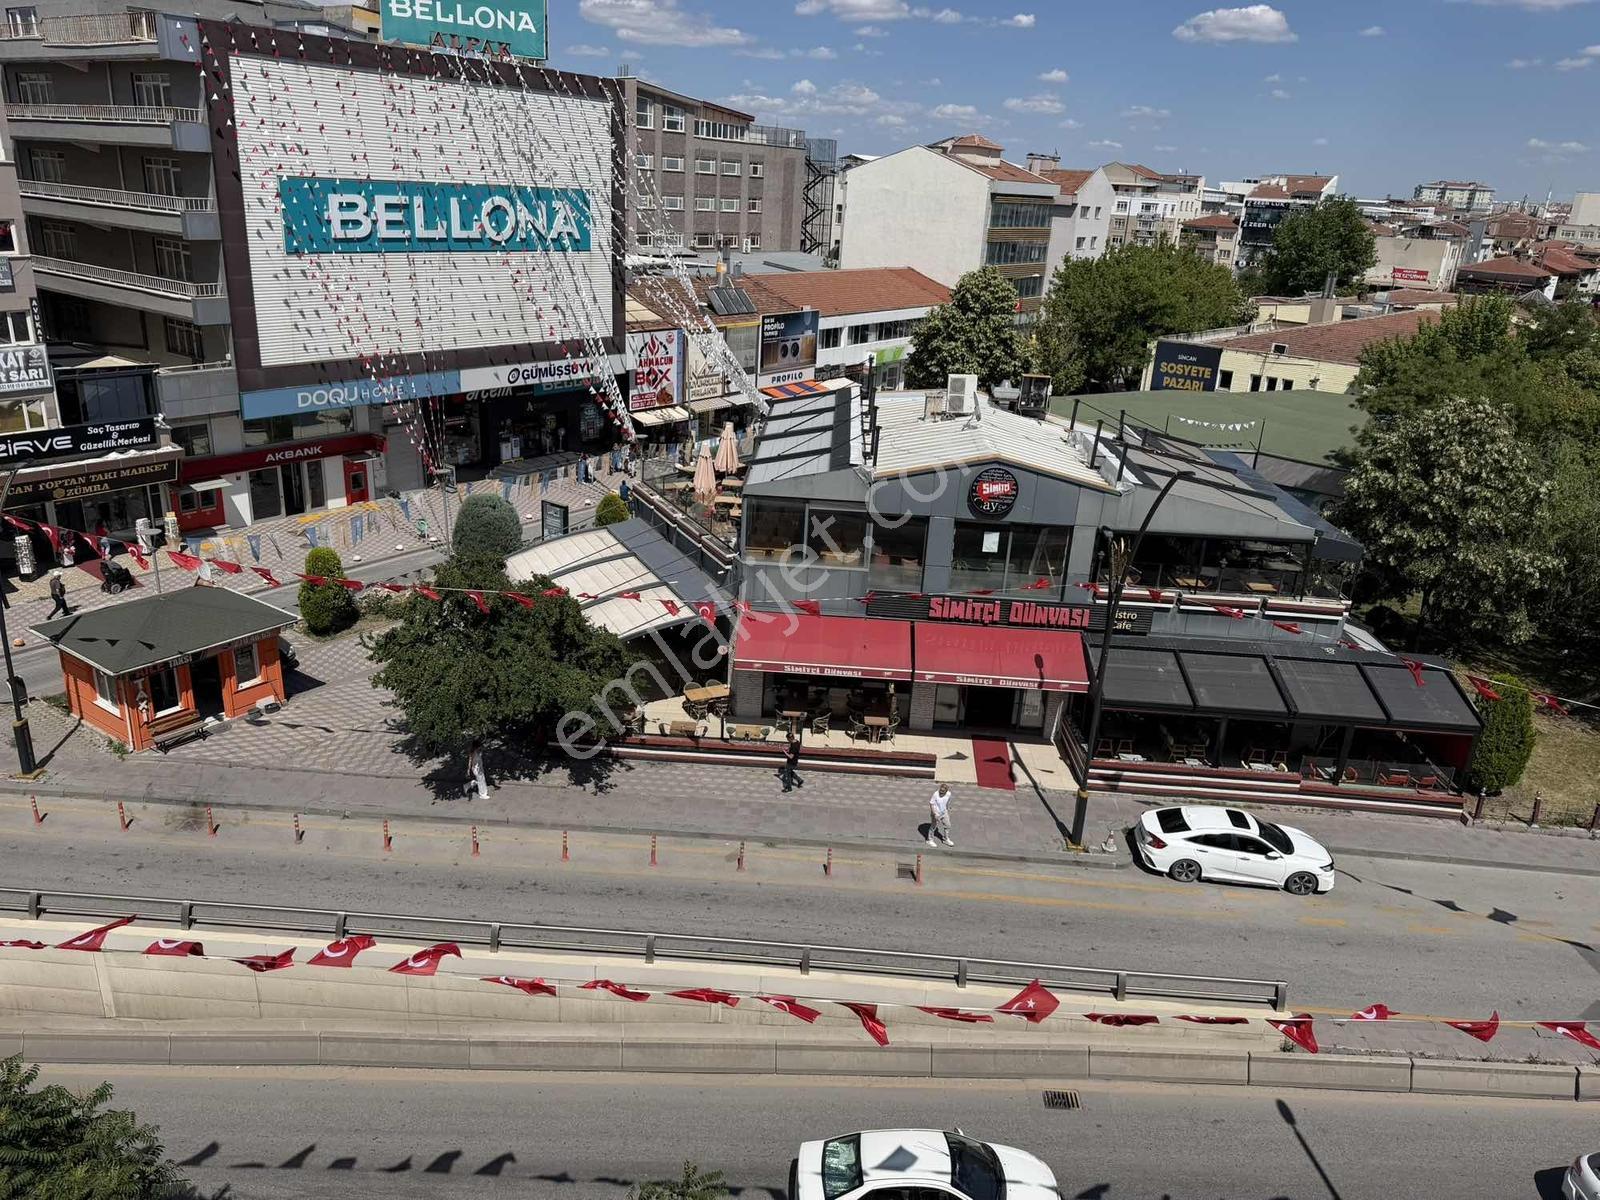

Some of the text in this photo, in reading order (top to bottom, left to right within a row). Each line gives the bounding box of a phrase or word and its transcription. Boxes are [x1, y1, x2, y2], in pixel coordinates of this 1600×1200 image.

[389, 0, 537, 33] BELLONA
[325, 194, 581, 242] BELLONA
[32, 299, 43, 343] AVUKAT
[9, 367, 44, 381] SARI
[635, 366, 671, 390] BOX
[1159, 361, 1213, 379] SOSYETE
[1162, 376, 1204, 392] PAZARI
[297, 385, 404, 408] DOQU HOME
[87, 422, 140, 435] Saç Tasarım
[80, 433, 151, 451] Güzellik Merkezi
[265, 445, 323, 463] AKBANK
[39, 476, 86, 491] TOPTAN
[89, 471, 118, 482] TAKI
[120, 463, 169, 478] MARKET
[929, 597, 1090, 627] SİMİTÇİ DÜNYASI
[1114, 609, 1138, 620] istro
